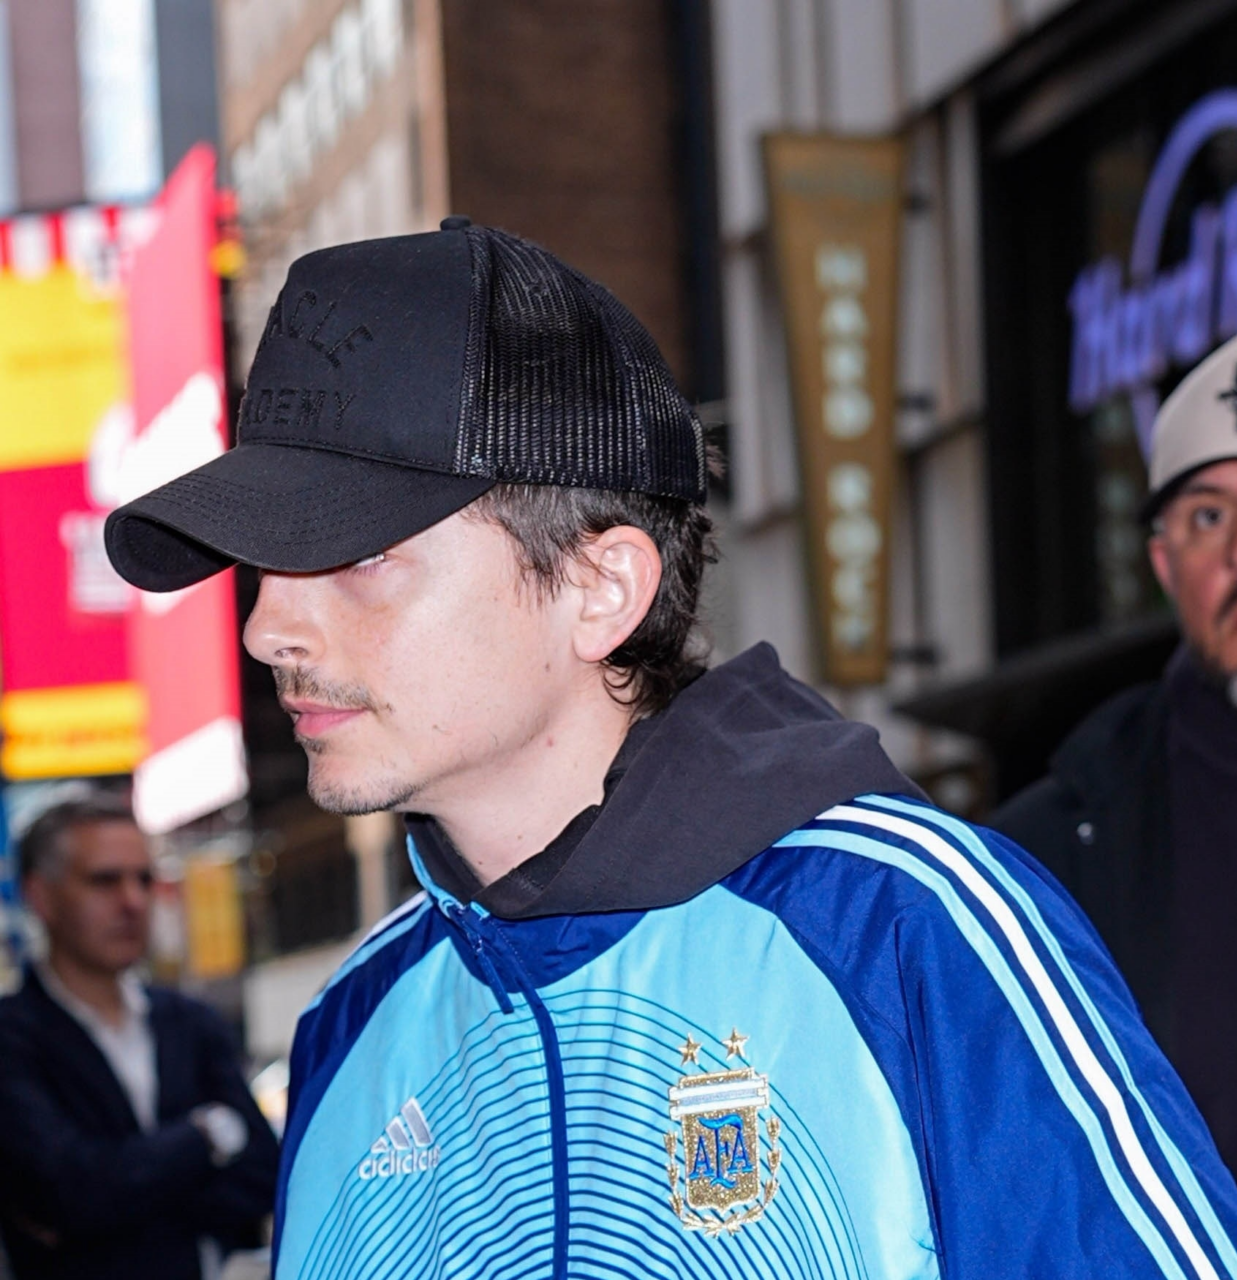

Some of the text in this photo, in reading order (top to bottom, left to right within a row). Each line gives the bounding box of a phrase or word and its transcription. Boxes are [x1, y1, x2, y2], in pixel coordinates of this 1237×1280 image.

[814, 243, 873, 440] HARD
[1066, 203, 1217, 412] Hard
[826, 463, 883, 650] ROCK
[359, 1146, 440, 1179] adidas
[689, 1114, 754, 1189] AFA
